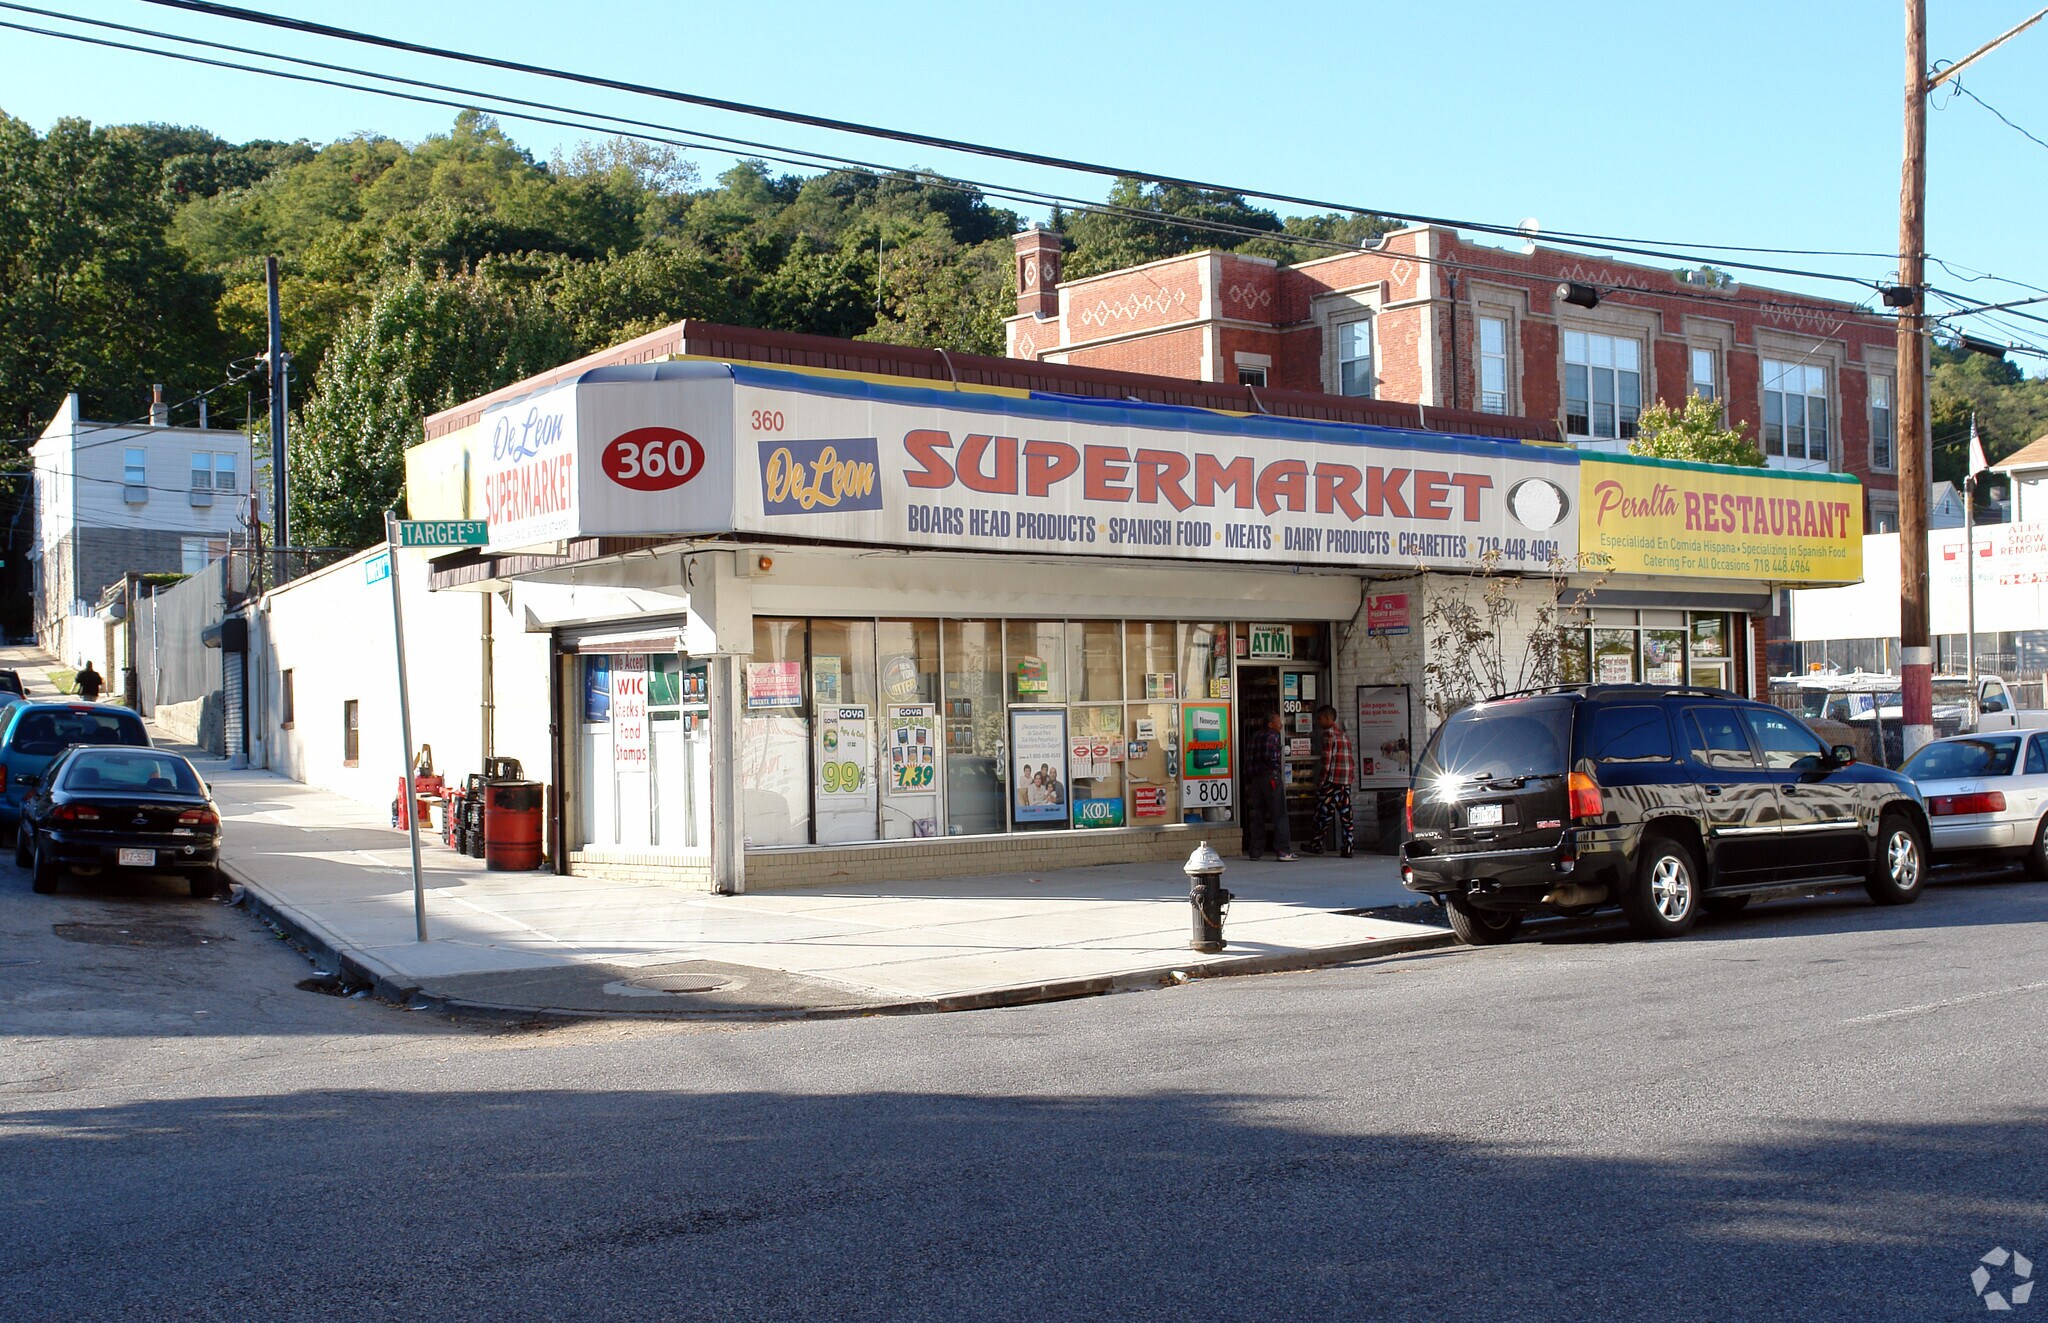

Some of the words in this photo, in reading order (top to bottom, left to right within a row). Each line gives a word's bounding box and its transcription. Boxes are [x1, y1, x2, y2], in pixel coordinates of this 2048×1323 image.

[751, 410, 784, 432] 360
[617, 439, 692, 479] 360
[902, 429, 1494, 522] SUPERMARKET
[486, 453, 572, 527] SUPERMARKET
[1594, 479, 1680, 527] Peralta
[1684, 491, 1850, 538] RESTAURANT
[404, 523, 467, 544] TARGEE
[467, 523, 482, 533] ST
[908, 504, 963, 535] BOARS
[969, 508, 1011, 538] HEAD
[1016, 512, 1096, 543] PRODUCTS
[1109, 517, 1171, 546] SPANISH
[1176, 521, 1212, 547] FOOD
[1225, 523, 1271, 550] MEATS
[1284, 526, 1322, 551] DAIRY
[1327, 529, 1390, 555] PRODUCTS
[1399, 532, 1467, 558] CIGARETTES
[2009, 534, 2044, 545] SNOW
[1601, 533, 1655, 549] Especialidad
[1657, 537, 1668, 549] En
[1671, 538, 1701, 552] Comida
[1704, 540, 1736, 555] Hispana
[1742, 542, 1787, 559] Specializing
[1789, 544, 1797, 556] In
[1798, 545, 1827, 560] Spanish
[1829, 546, 1847, 558] Food
[1644, 554, 1680, 571] Catering
[1682, 556, 1696, 568] For
[1698, 556, 1709, 569] All
[1711, 557, 1750, 571] Occasions
[1754, 558, 1770, 572] 718
[1772, 559, 1811, 573] 448.4964
[617, 678, 644, 695] WIC
[615, 700, 639, 718] Checks
[840, 710, 864, 718] GOYA
[900, 708, 922, 716] GOYA
[1284, 701, 1301, 712] 360
[891, 717, 933, 730] BEANS
[1200, 716, 1219, 726] Newport
[620, 722, 641, 739] Food
[616, 744, 647, 765] Stamps
[1186, 738, 1227, 753] pleasure!
[1083, 803, 1113, 818] KOOL
